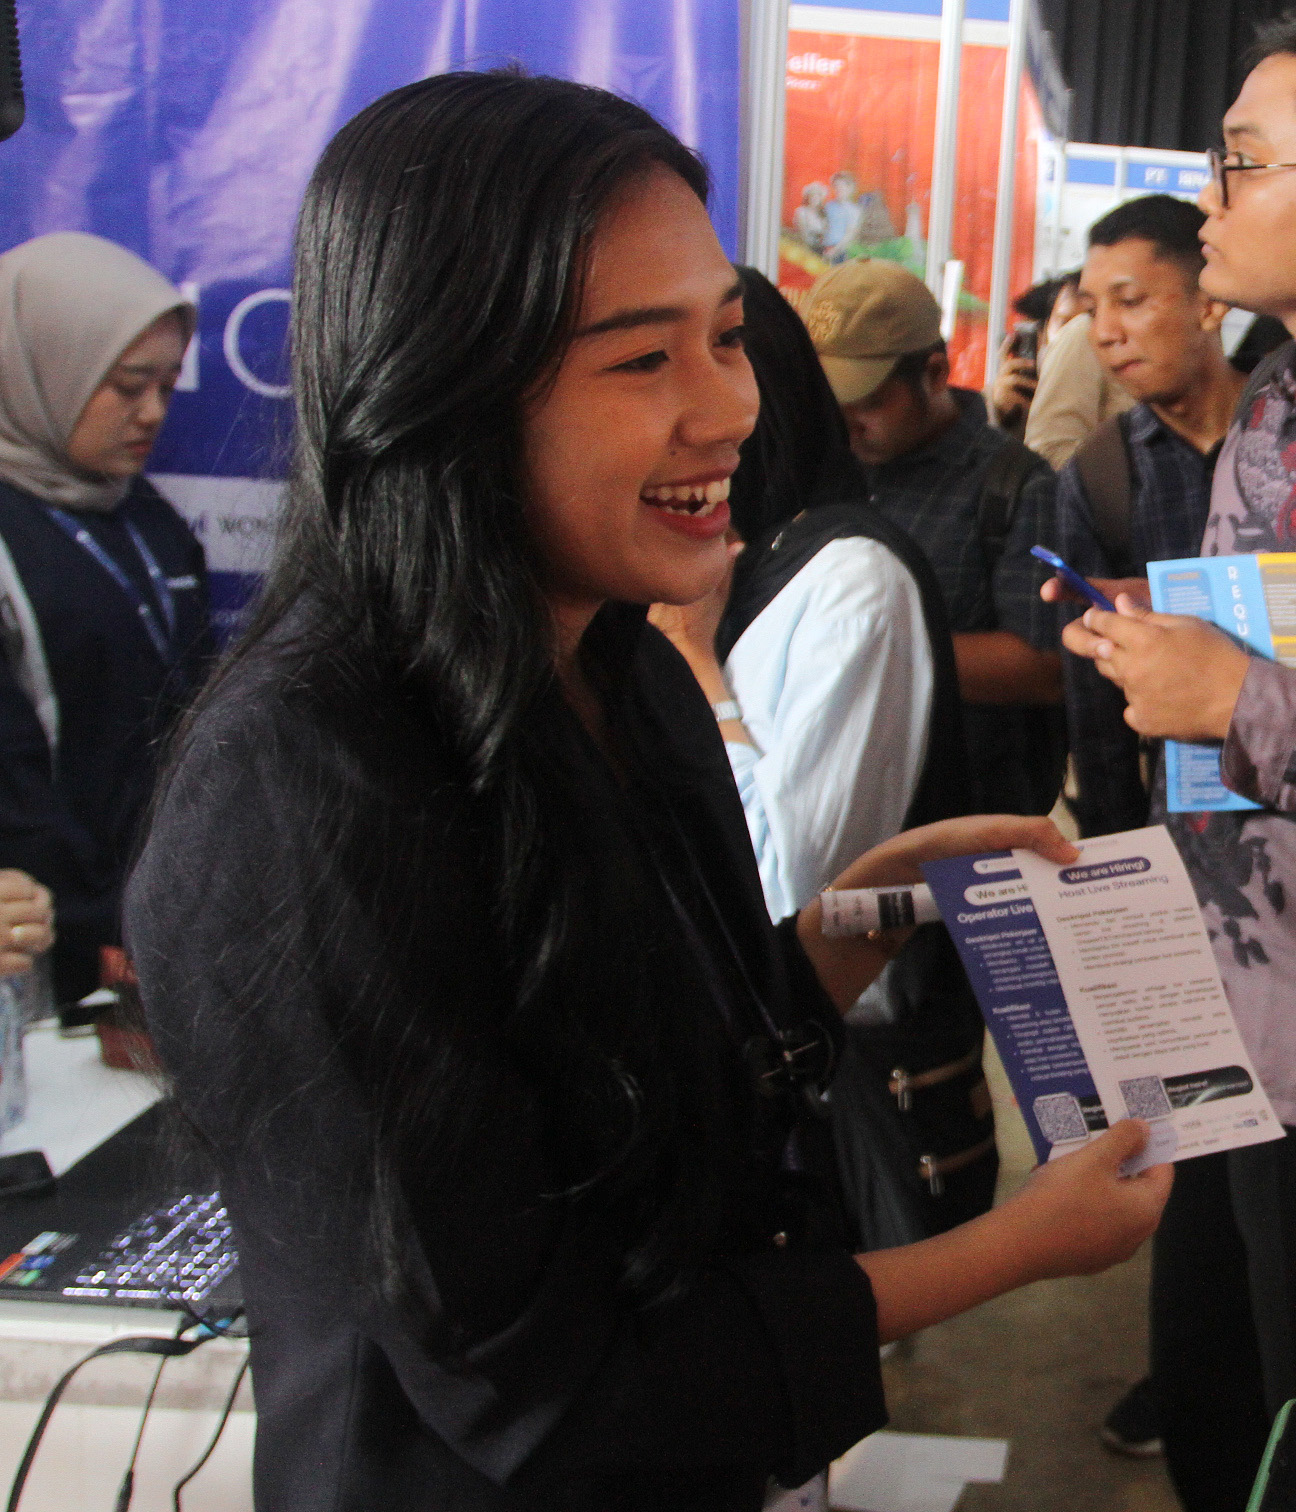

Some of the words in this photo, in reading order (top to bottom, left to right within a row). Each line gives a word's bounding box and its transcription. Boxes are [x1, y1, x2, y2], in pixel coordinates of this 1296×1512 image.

[1066, 870, 1089, 881] We
[1090, 867, 1109, 877] are
[1087, 884, 1110, 894] Live
[1112, 875, 1169, 890] Streaming
[957, 908, 1009, 924] Operator
[1009, 903, 1034, 915] Live
